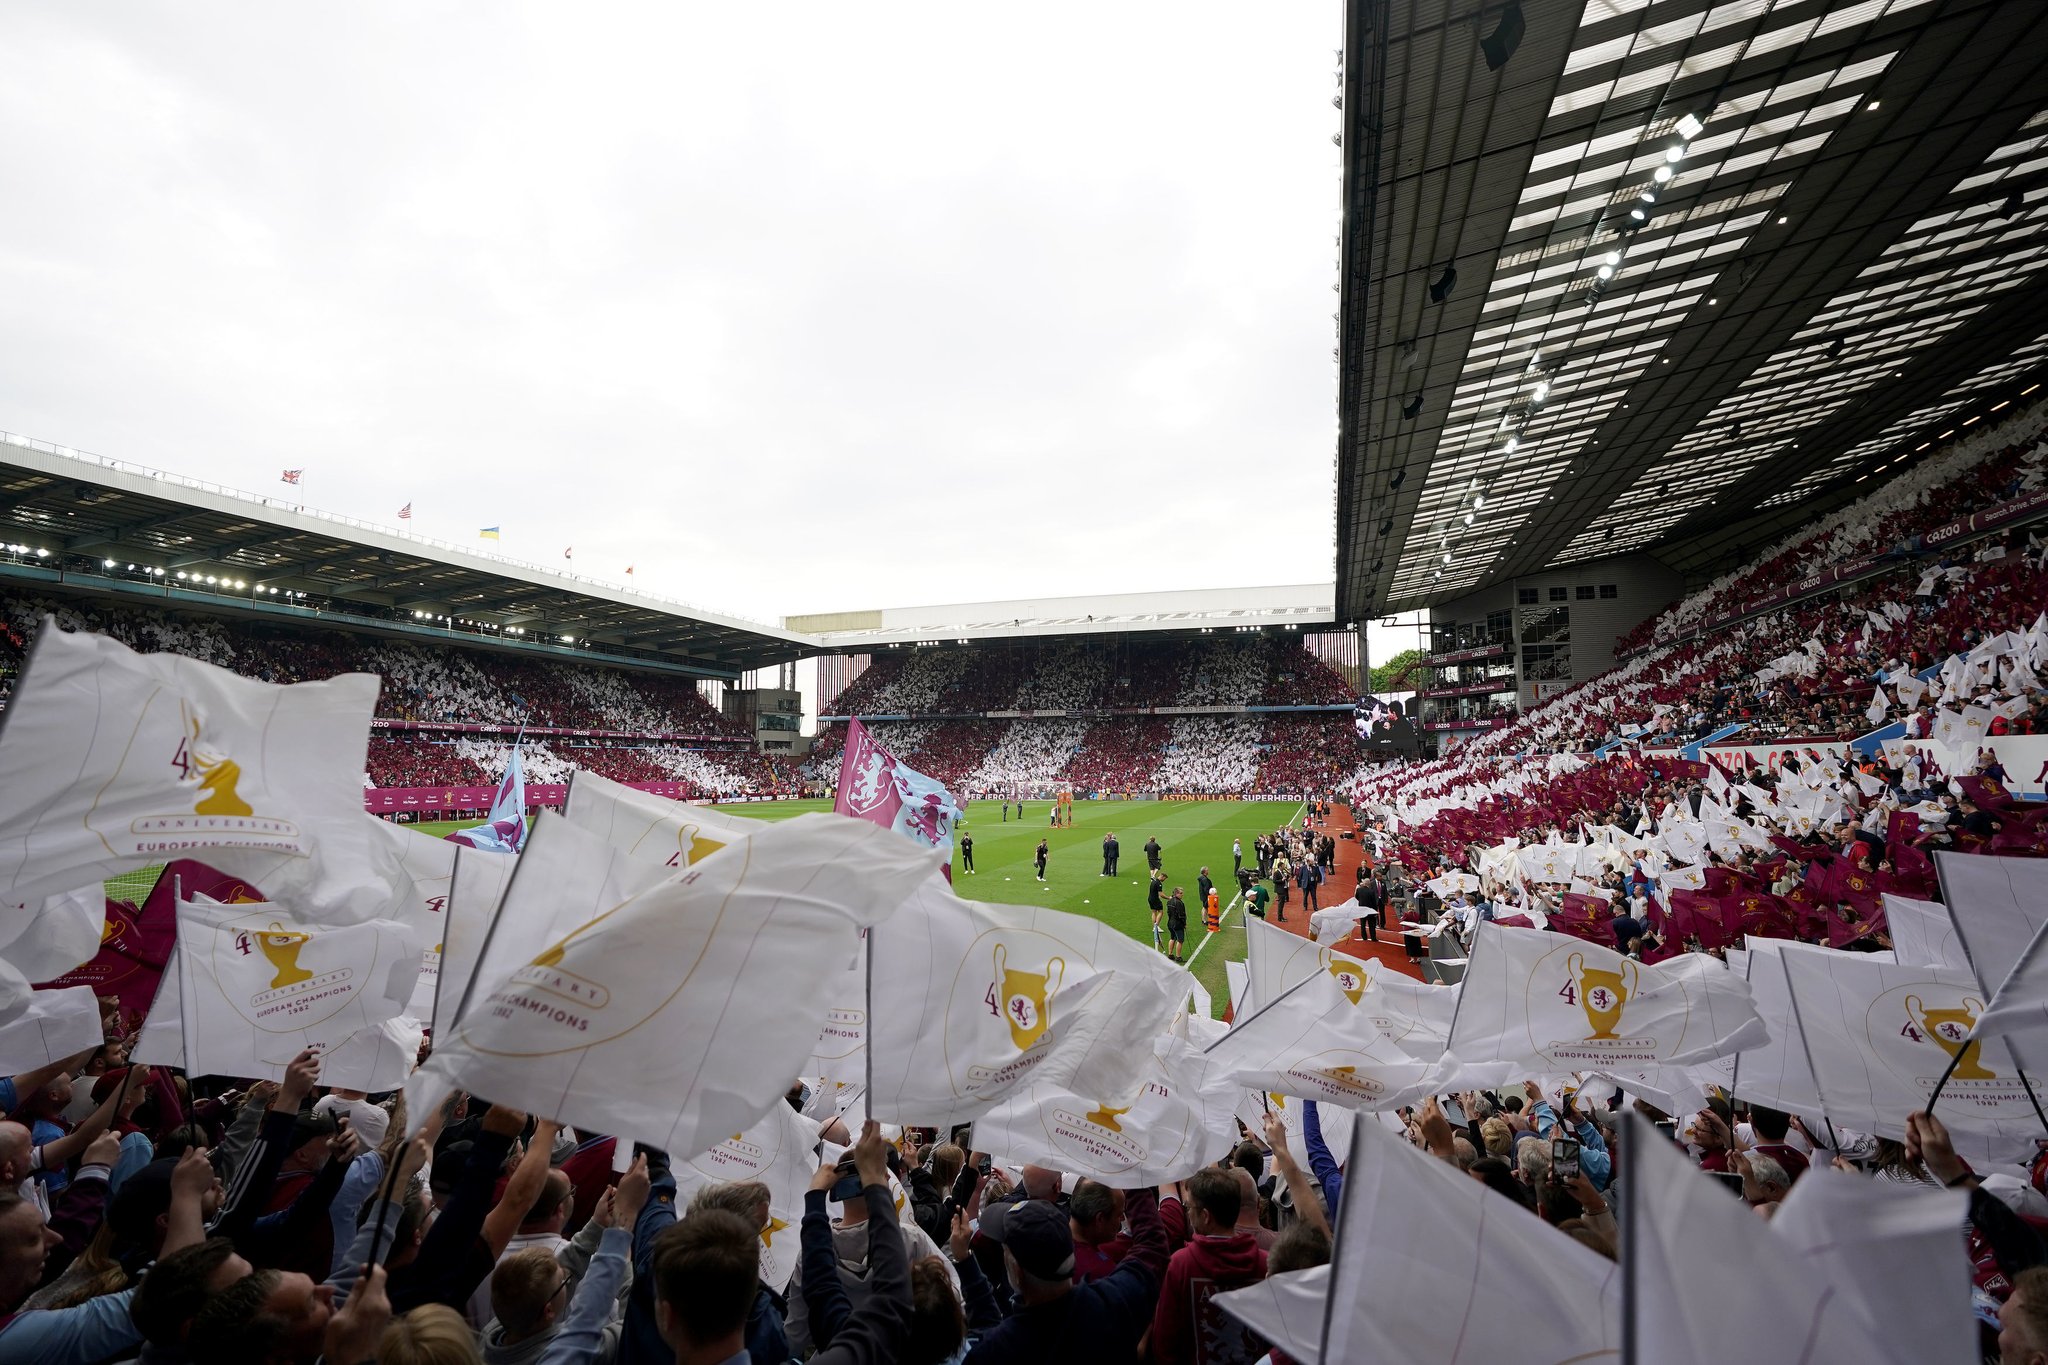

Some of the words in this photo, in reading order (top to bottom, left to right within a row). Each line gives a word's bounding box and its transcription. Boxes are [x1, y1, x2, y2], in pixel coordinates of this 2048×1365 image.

[2009, 502, 2030, 512] Drive.
[1926, 523, 1960, 544] CAZOO
[1800, 576, 1820, 590] CAZOO
[1715, 611, 1730, 622] CAZOO
[172, 736, 190, 780] 4
[142, 818, 292, 832] ANNIVERSARY
[425, 896, 448, 912] 4
[114, 938, 128, 952] TH
[236, 932, 252, 956] 4
[984, 982, 1000, 1018] 4
[1558, 978, 1576, 1006] 4
[256, 1002, 292, 1018] EUROPEAN
[296, 985, 352, 1006] CHAMPIONS
[288, 1004, 309, 1015] 1982
[822, 1028, 860, 1038] AMPIONS
[1900, 1020, 1924, 1043] 4
[994, 1073, 1016, 1084] 1982
[1288, 1070, 1328, 1086] EUROPEAN
[1324, 1068, 1378, 1089] VERSARY
[1150, 1083, 1168, 1097] TH
[1321, 1086, 1339, 1096] 1982
[1059, 1113, 1142, 1155] ANNIVERSARY
[1056, 1128, 1094, 1145] EUROPEAN
[1096, 1142, 1129, 1163] CHAMPIO
[1086, 1146, 1104, 1156] 1982
[711, 1155, 726, 1165] 1982
[718, 1151, 757, 1168] CHAMPIONS
